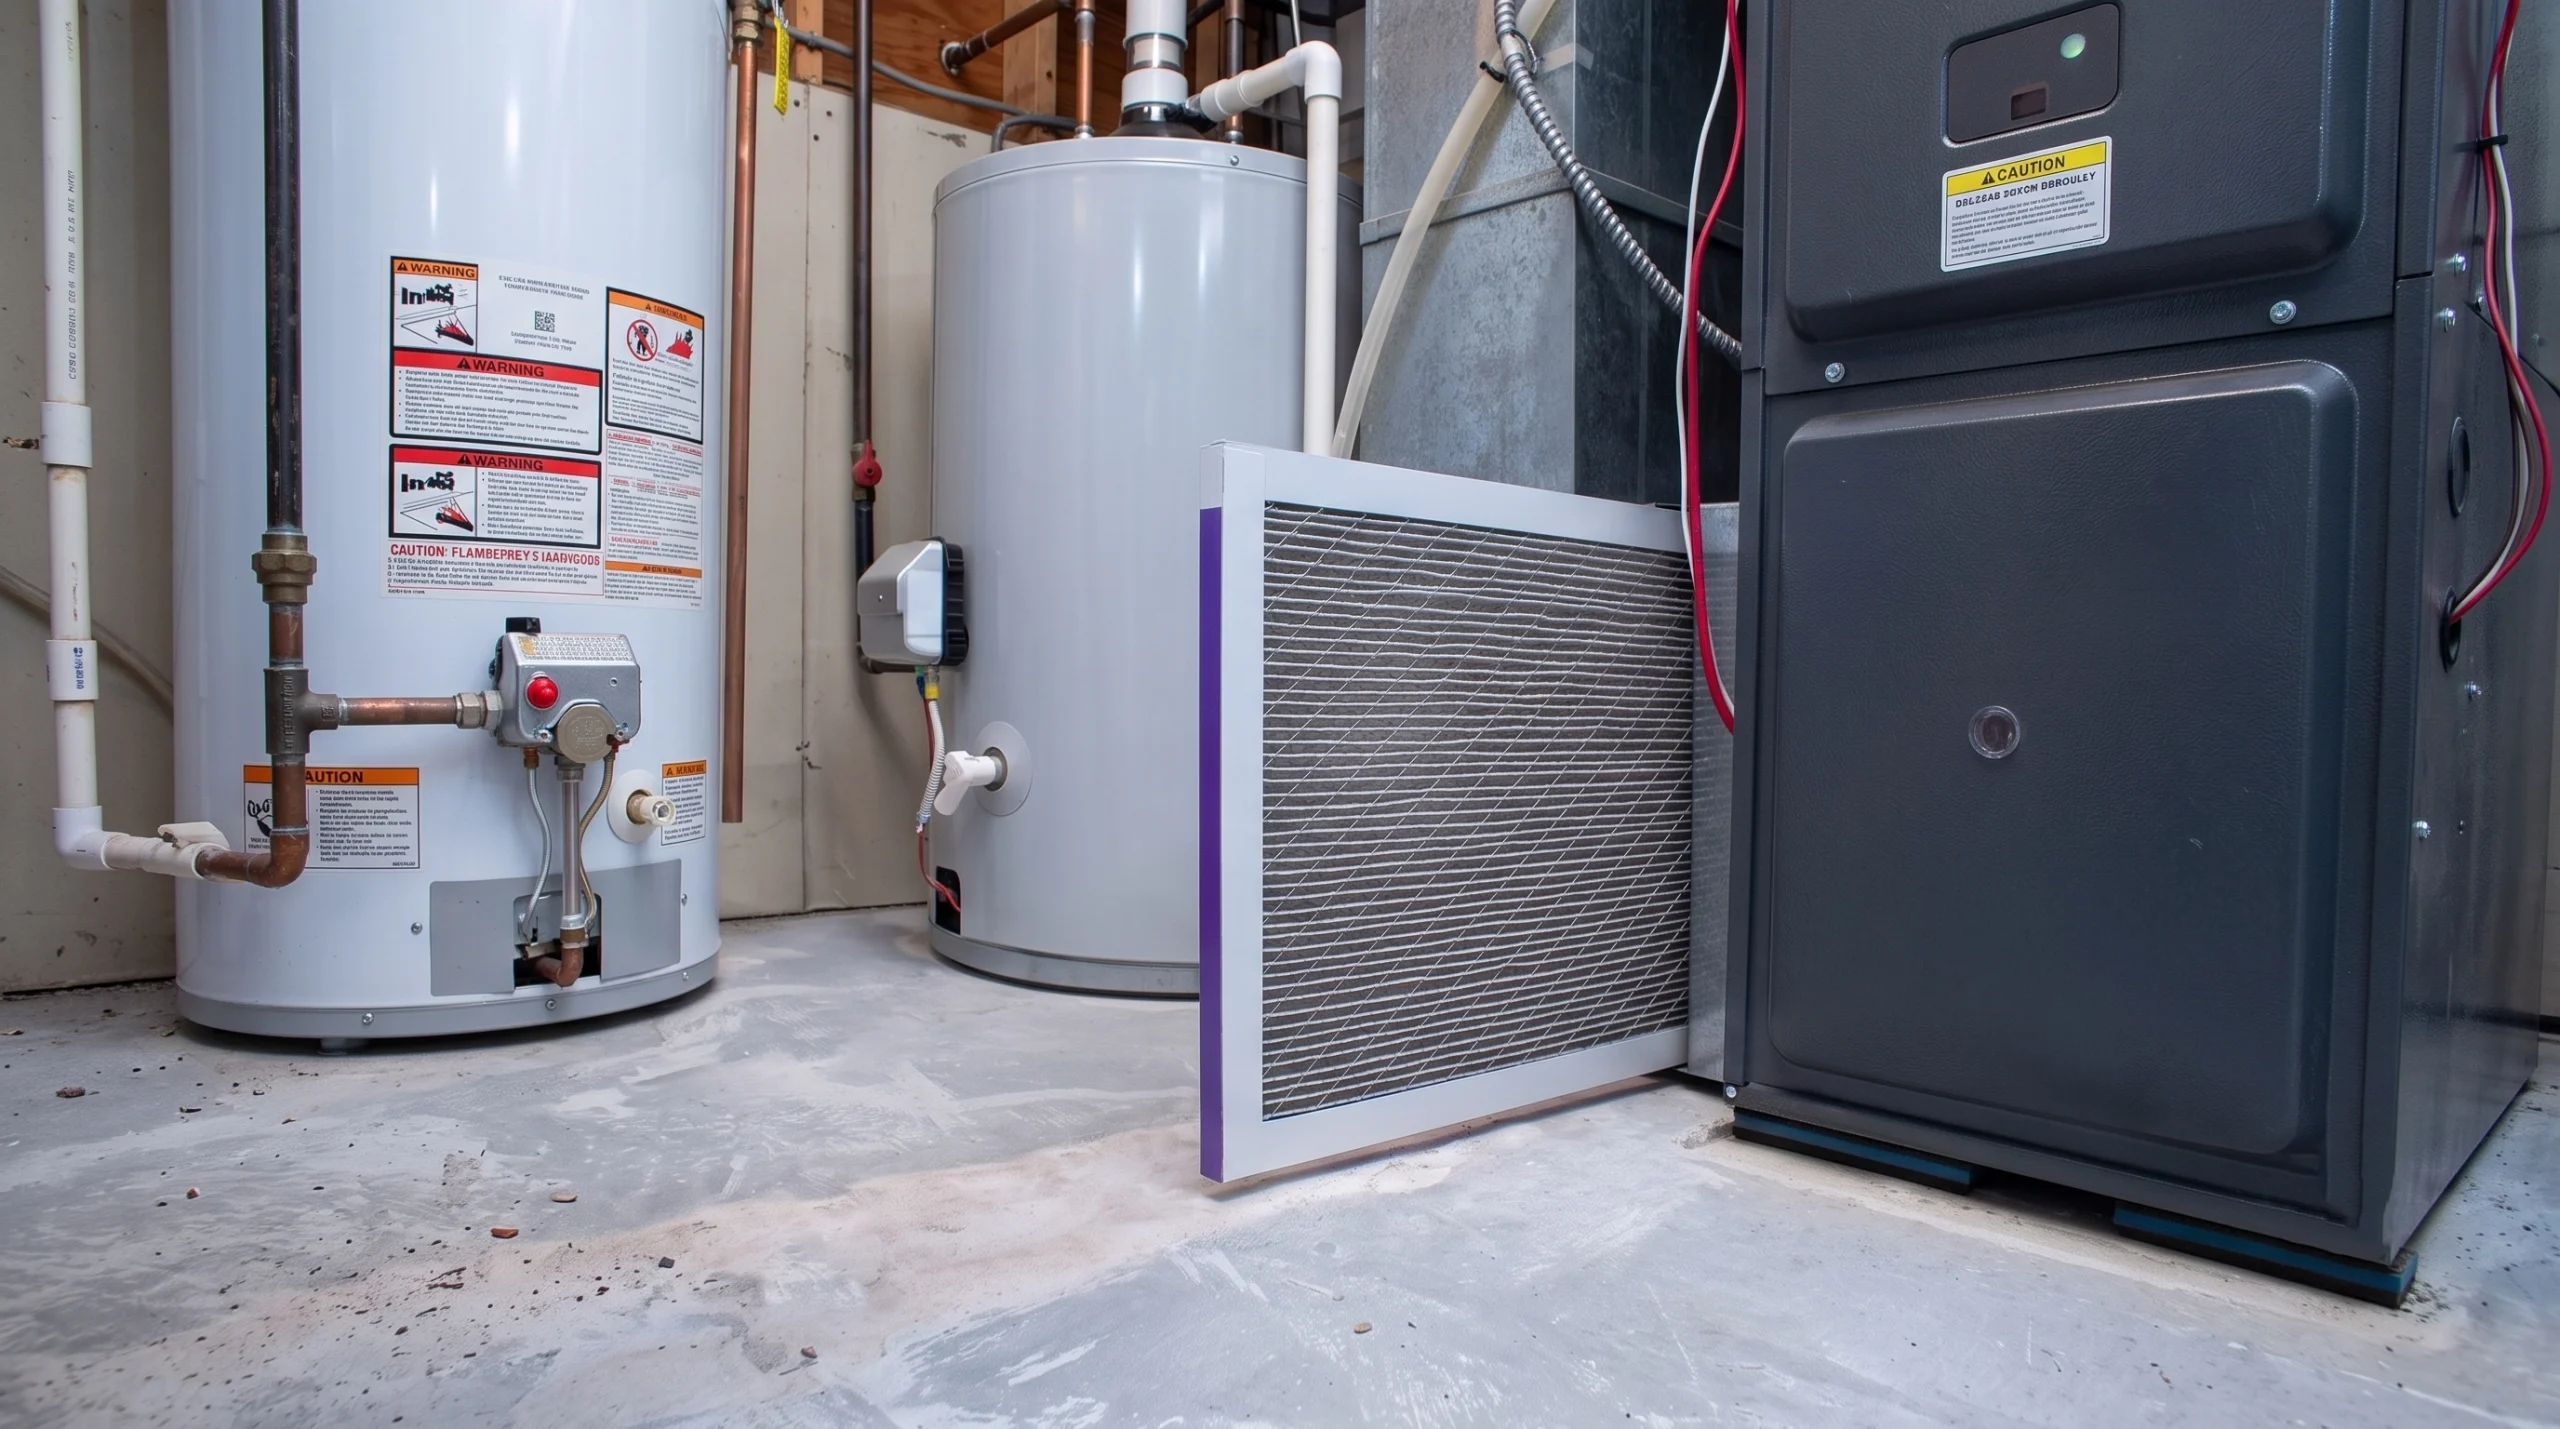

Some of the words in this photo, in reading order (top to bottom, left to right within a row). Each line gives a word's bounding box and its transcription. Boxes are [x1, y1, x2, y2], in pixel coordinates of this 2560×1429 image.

[1997, 155, 2065, 181] CAUTION
[411, 262, 475, 278] WARNING
[473, 359, 544, 377] WARNING
[473, 455, 543, 471] WARNING
[305, 770, 363, 783] AUTION
